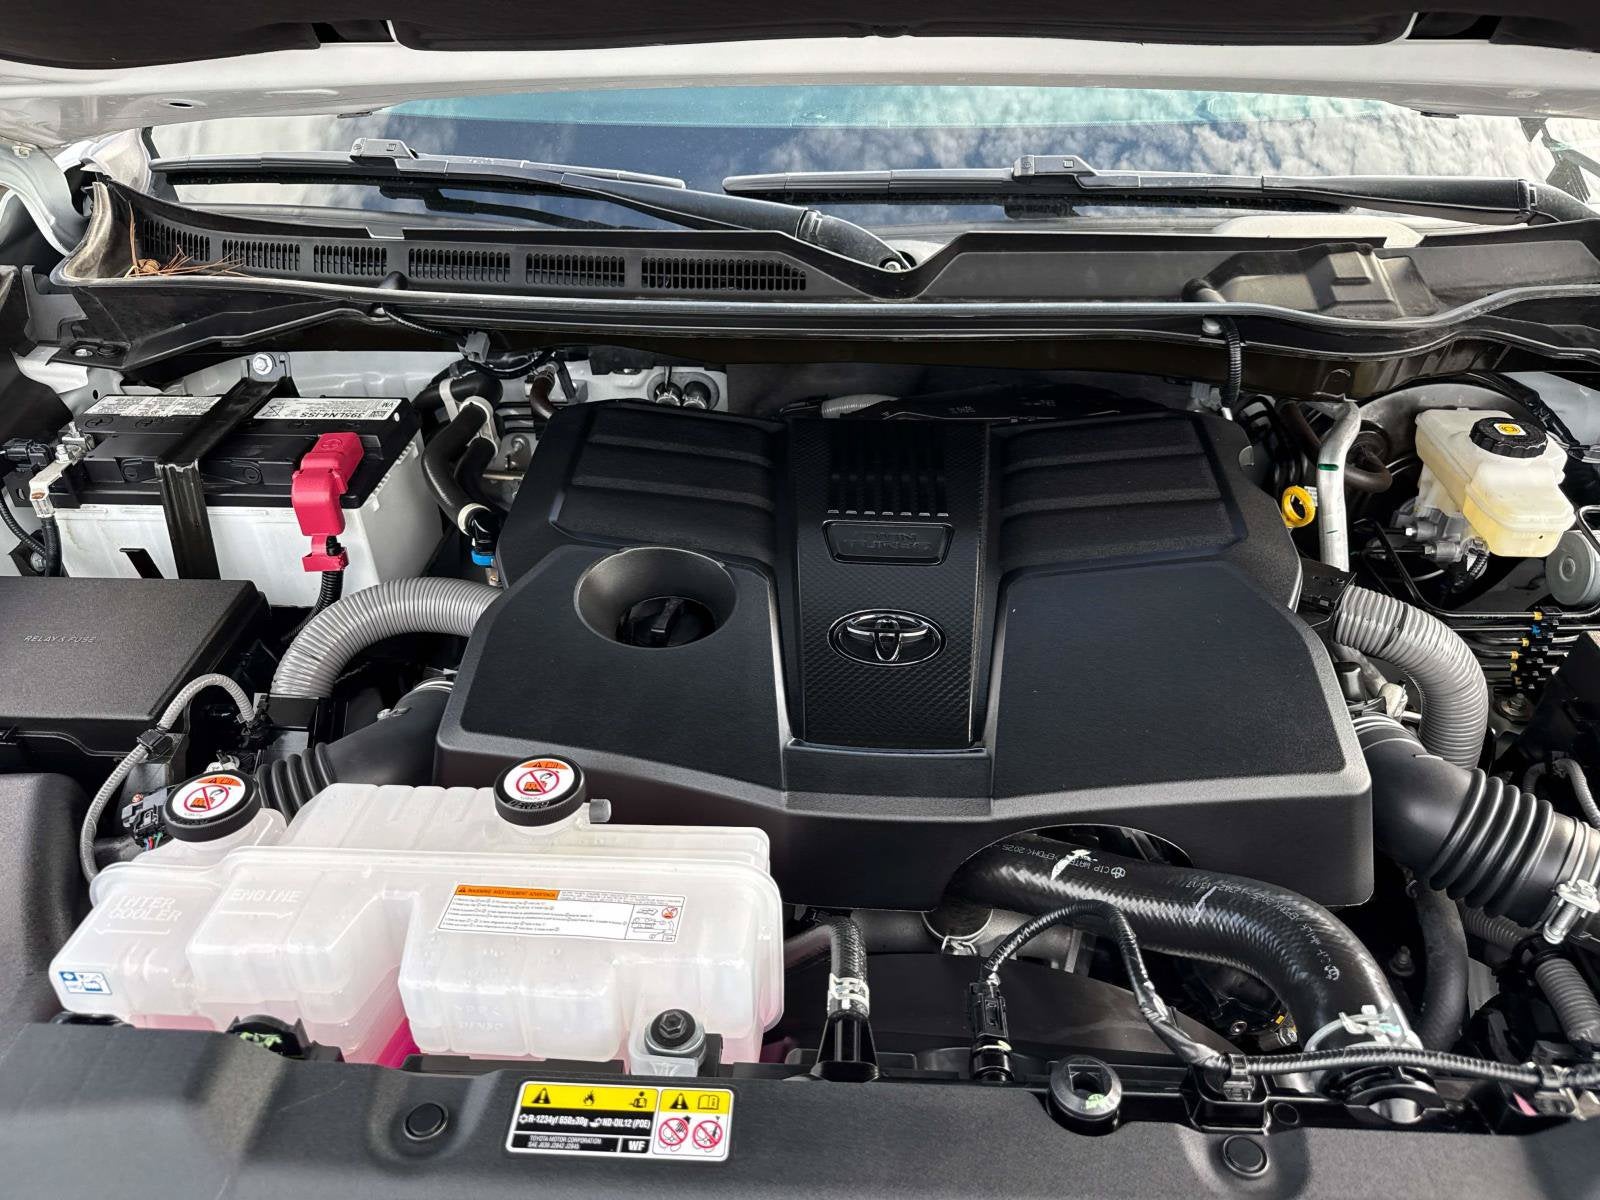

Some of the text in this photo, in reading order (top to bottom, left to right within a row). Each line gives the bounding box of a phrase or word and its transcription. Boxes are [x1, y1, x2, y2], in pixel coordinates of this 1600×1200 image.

[114, 895, 176, 908] INTER
[230, 888, 304, 903] ENGINE
[108, 907, 183, 922] COOLER
[528, 1114, 558, 1126] R-1234yf
[548, 1135, 567, 1143] MOTOR
[567, 1136, 602, 1145] CORPORATION
[627, 1140, 646, 1151] WF
